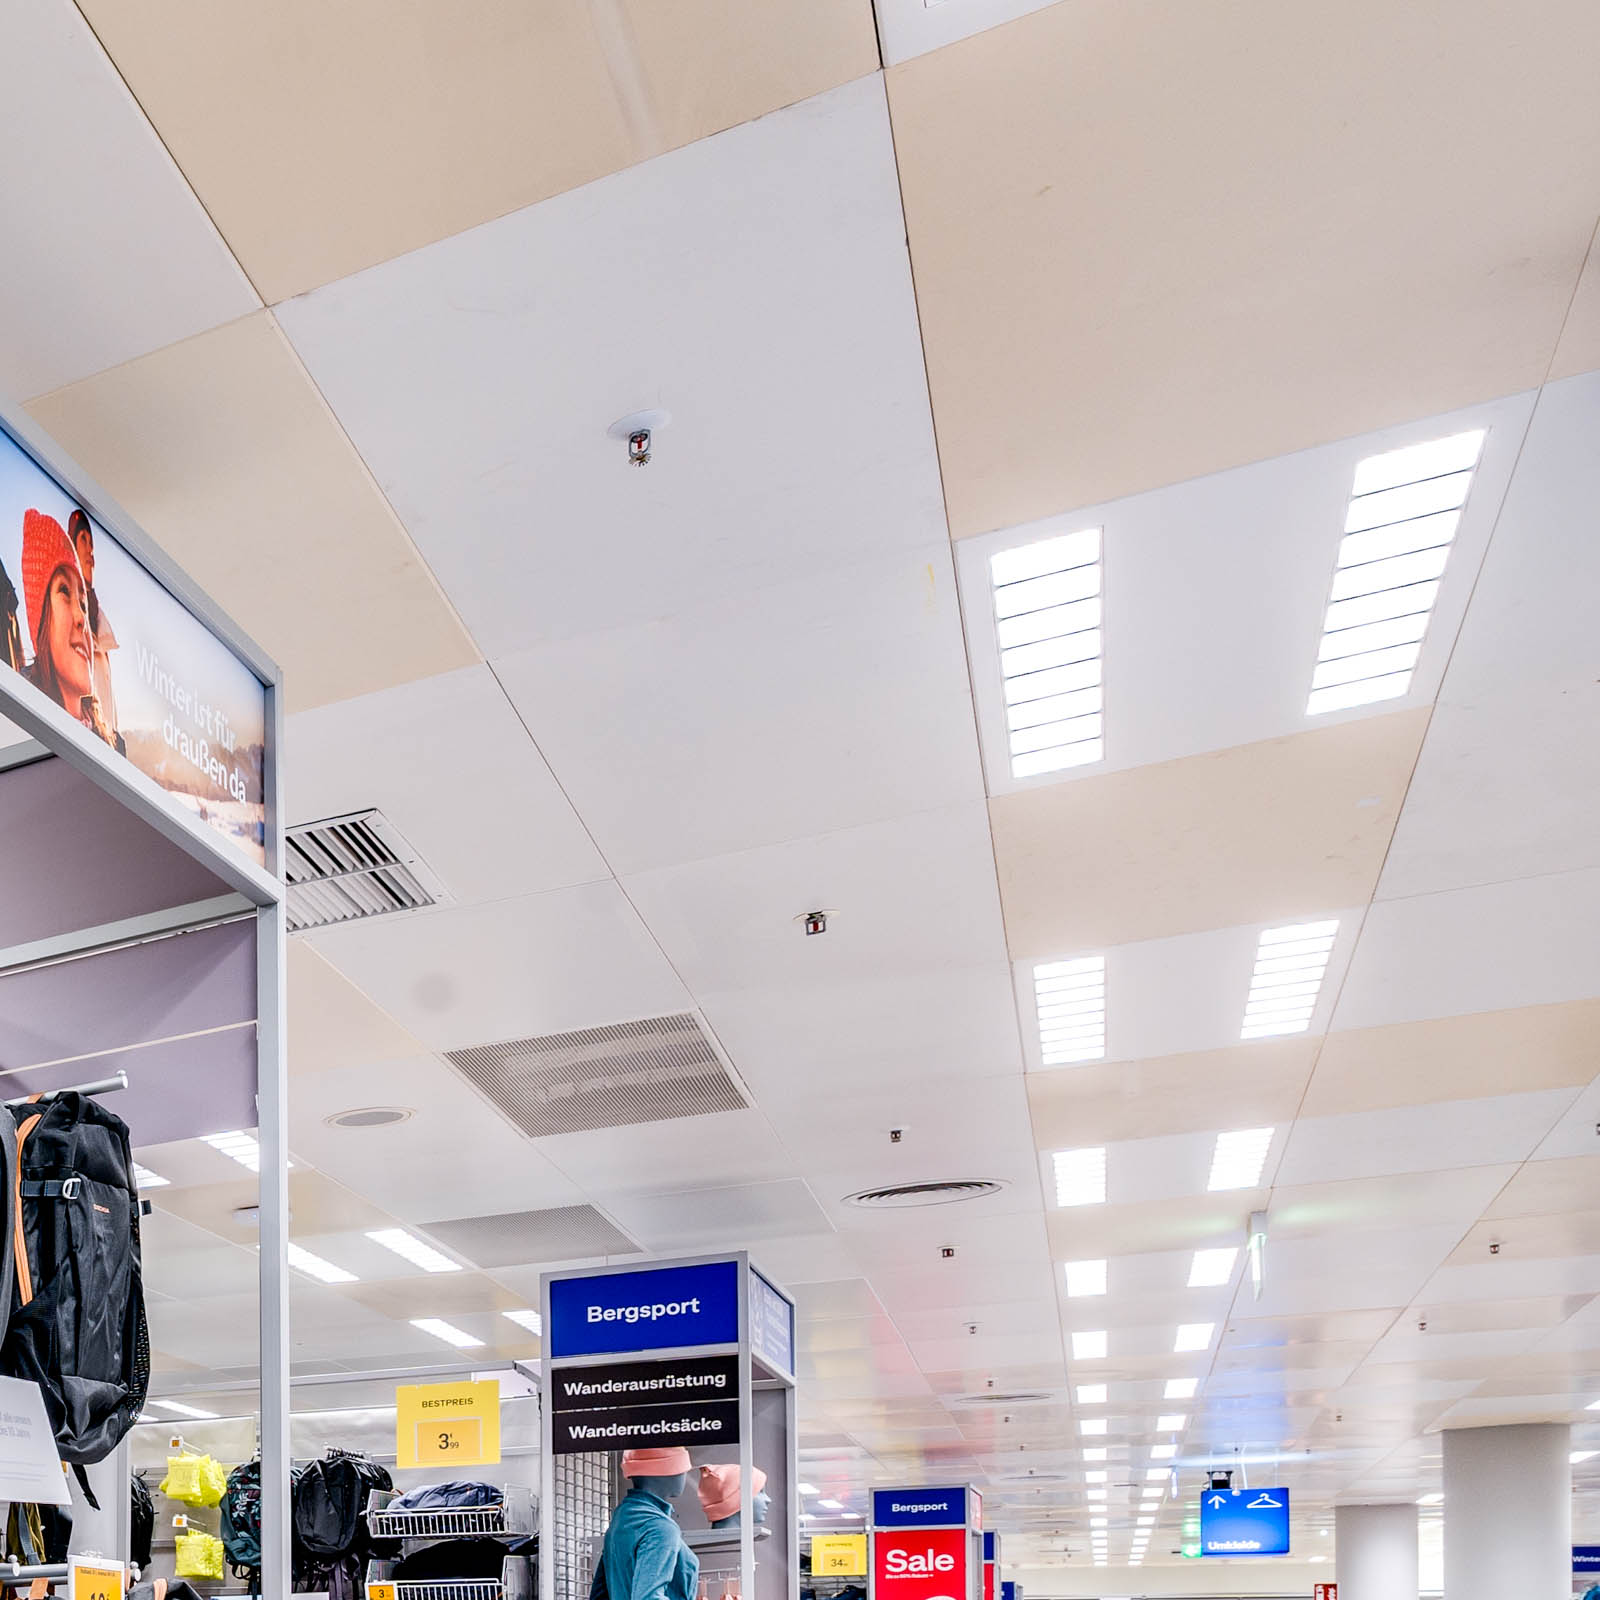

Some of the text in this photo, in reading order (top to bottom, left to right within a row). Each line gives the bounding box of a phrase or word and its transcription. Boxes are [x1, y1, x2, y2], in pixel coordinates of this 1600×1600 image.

[135, 640, 236, 754] Winter ist für
[163, 712, 246, 807] draußen da
[587, 1298, 700, 1323] Bergsport
[564, 1373, 726, 1396] Wanderausrüstung
[422, 1397, 474, 1408] BESTPREIS
[569, 1418, 722, 1439] Wanderrucksäcke
[891, 1502, 948, 1513] Bergsport
[1208, 1541, 1260, 1550] Umkleide
[885, 1548, 955, 1573] Sale
